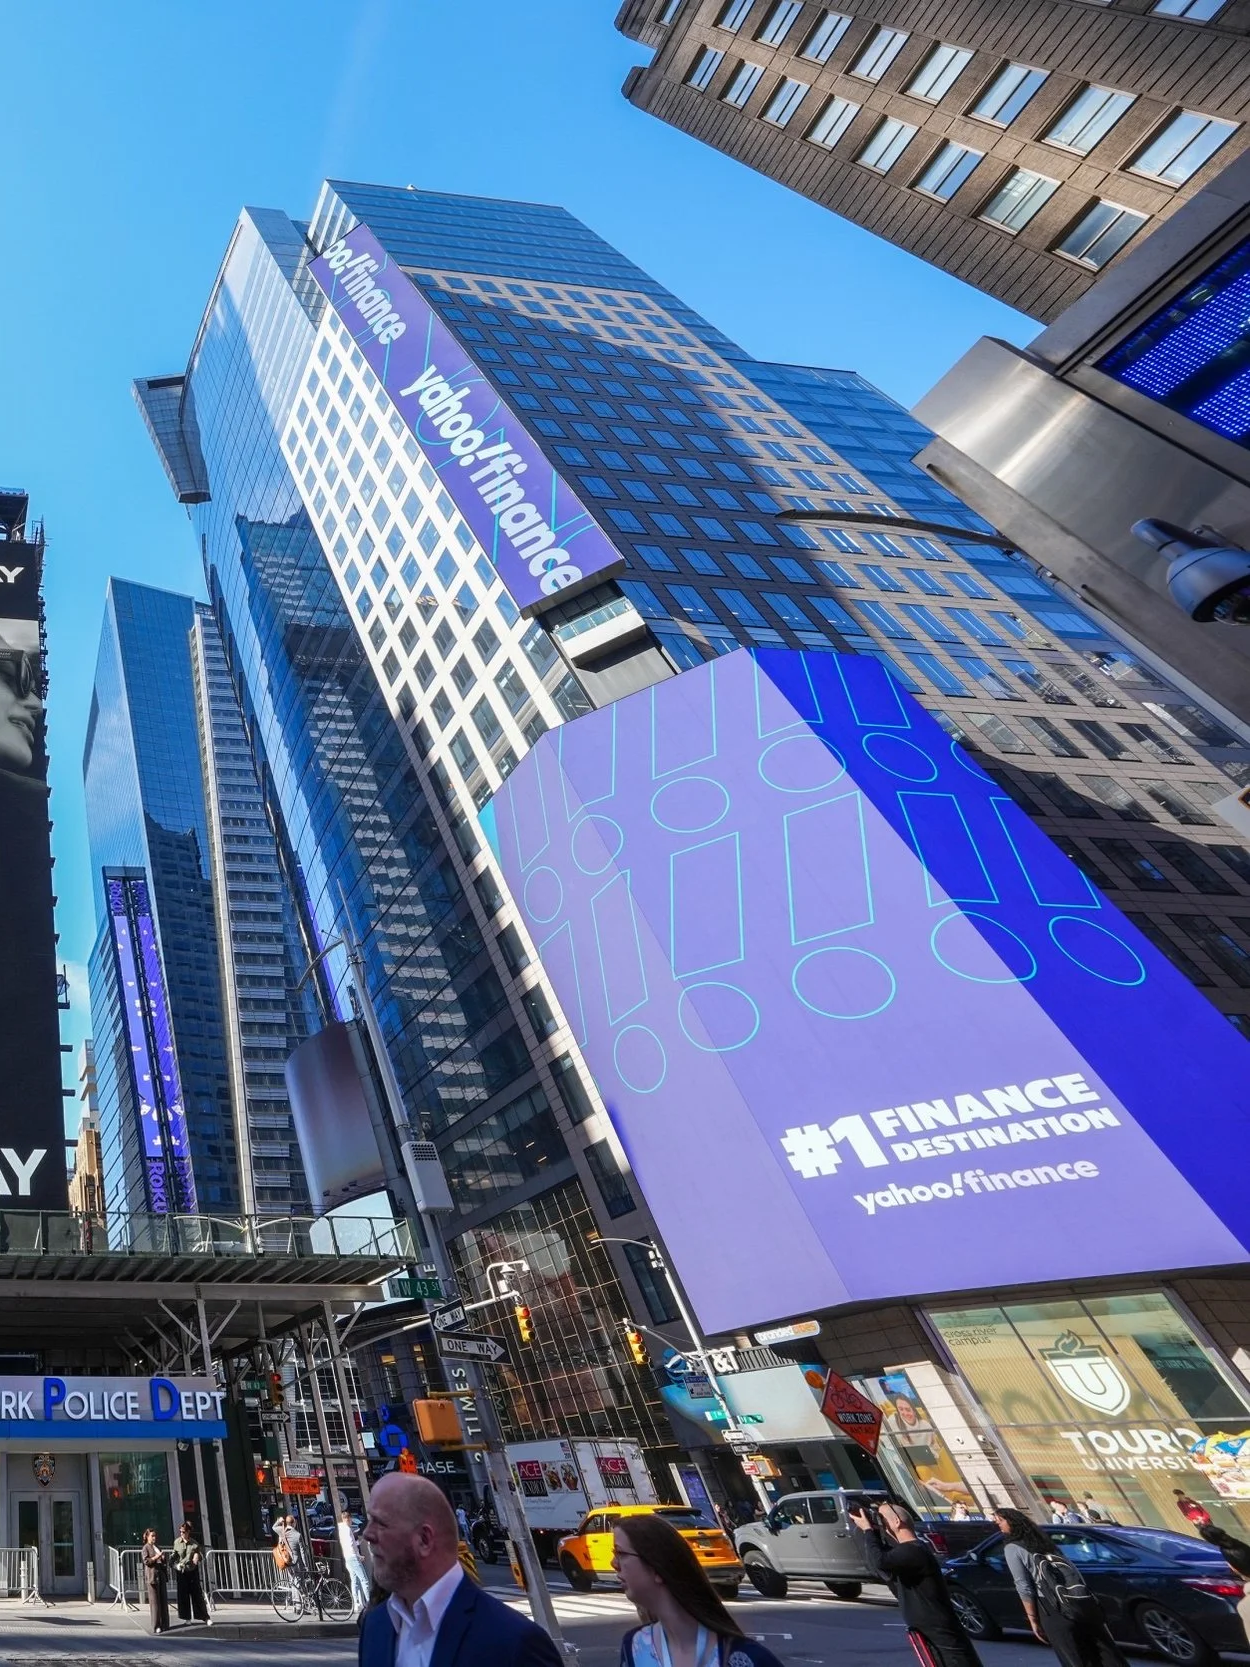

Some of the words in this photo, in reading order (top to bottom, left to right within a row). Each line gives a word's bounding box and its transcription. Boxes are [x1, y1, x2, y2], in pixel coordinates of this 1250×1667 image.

[779, 1113, 890, 1179] #1
[869, 1073, 1100, 1139] FINANCE
[890, 1106, 1122, 1163] DESTINATION
[400, 1281, 412, 1296] W
[416, 1281, 429, 1296] 43
[437, 1317, 447, 1327] ONE
[451, 1308, 462, 1321] WAY
[943, 1328, 970, 1339] cross
[971, 1325, 998, 1336] river
[447, 1340, 468, 1352] ONE
[476, 1342, 498, 1355] WAY
[948, 1335, 991, 1347] campus
[42, 1376, 141, 1421] POLICE
[149, 1376, 225, 1421] DEPT
[451, 1367, 482, 1436] TIMES
[837, 1412, 858, 1424] WORK
[856, 1412, 875, 1424] ZONE
[1060, 1427, 1203, 1456] TOURO
[415, 1461, 456, 1474] HASE
[519, 1463, 542, 1477] ACE
[600, 1458, 628, 1472] ACE
